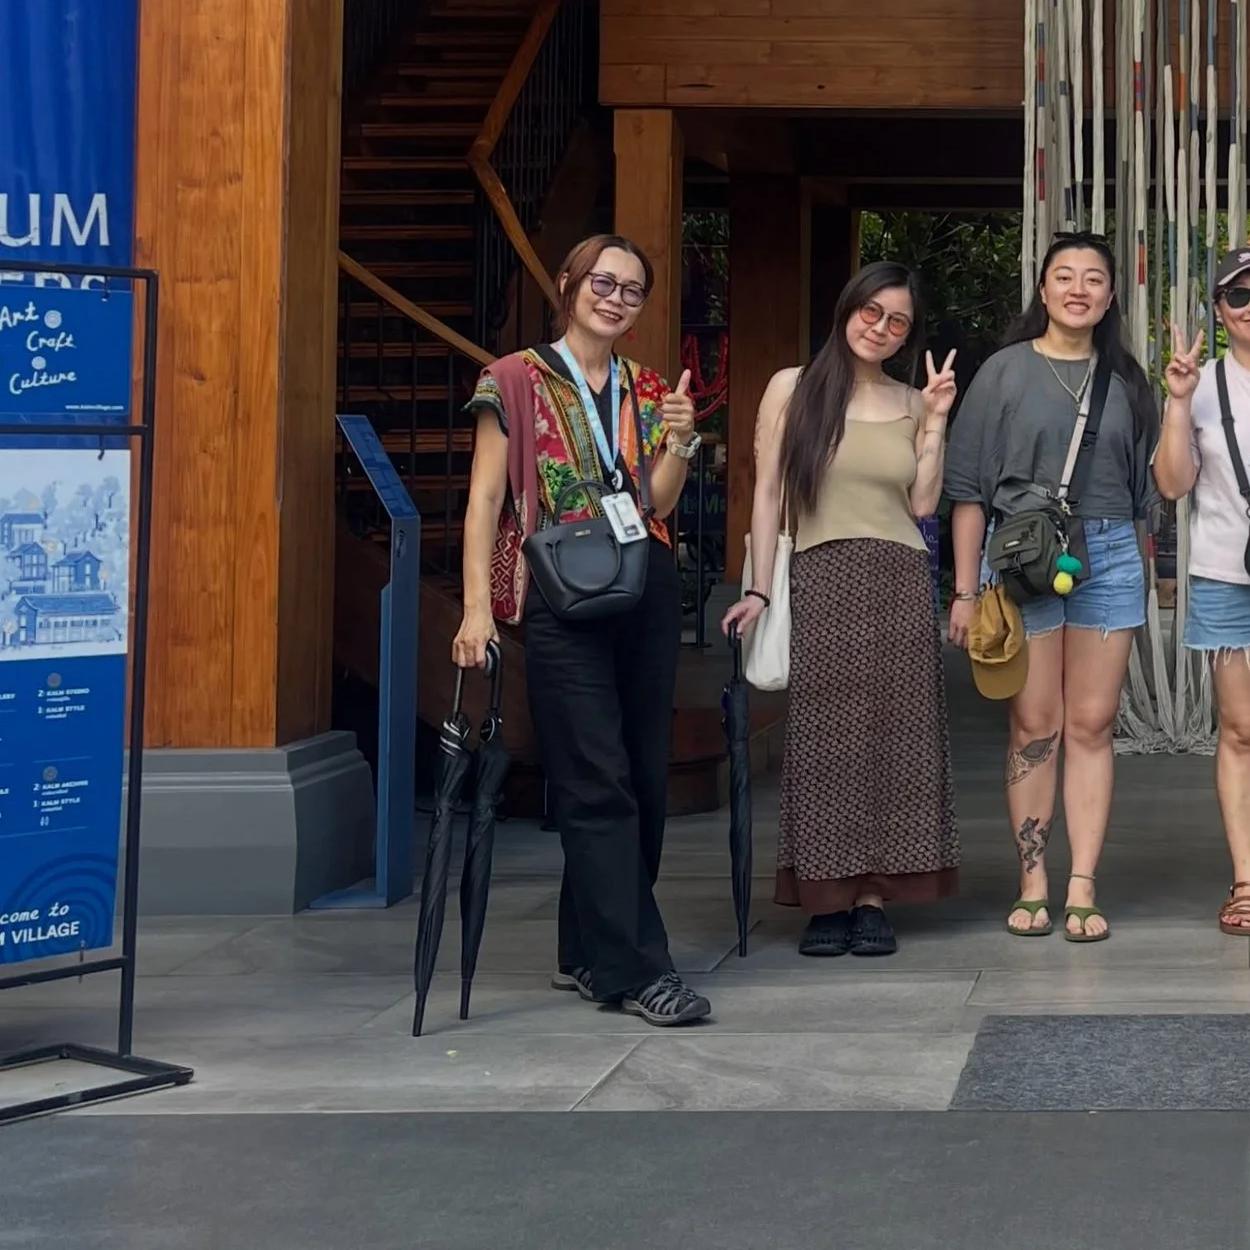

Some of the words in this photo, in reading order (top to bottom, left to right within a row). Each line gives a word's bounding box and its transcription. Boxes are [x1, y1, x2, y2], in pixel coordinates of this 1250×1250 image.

[0, 302, 39, 330] Art
[27, 331, 77, 352] Craft
[10, 371, 77, 395] Culture
[48, 902, 70, 917] to
[12, 921, 80, 944] VILLAGE
